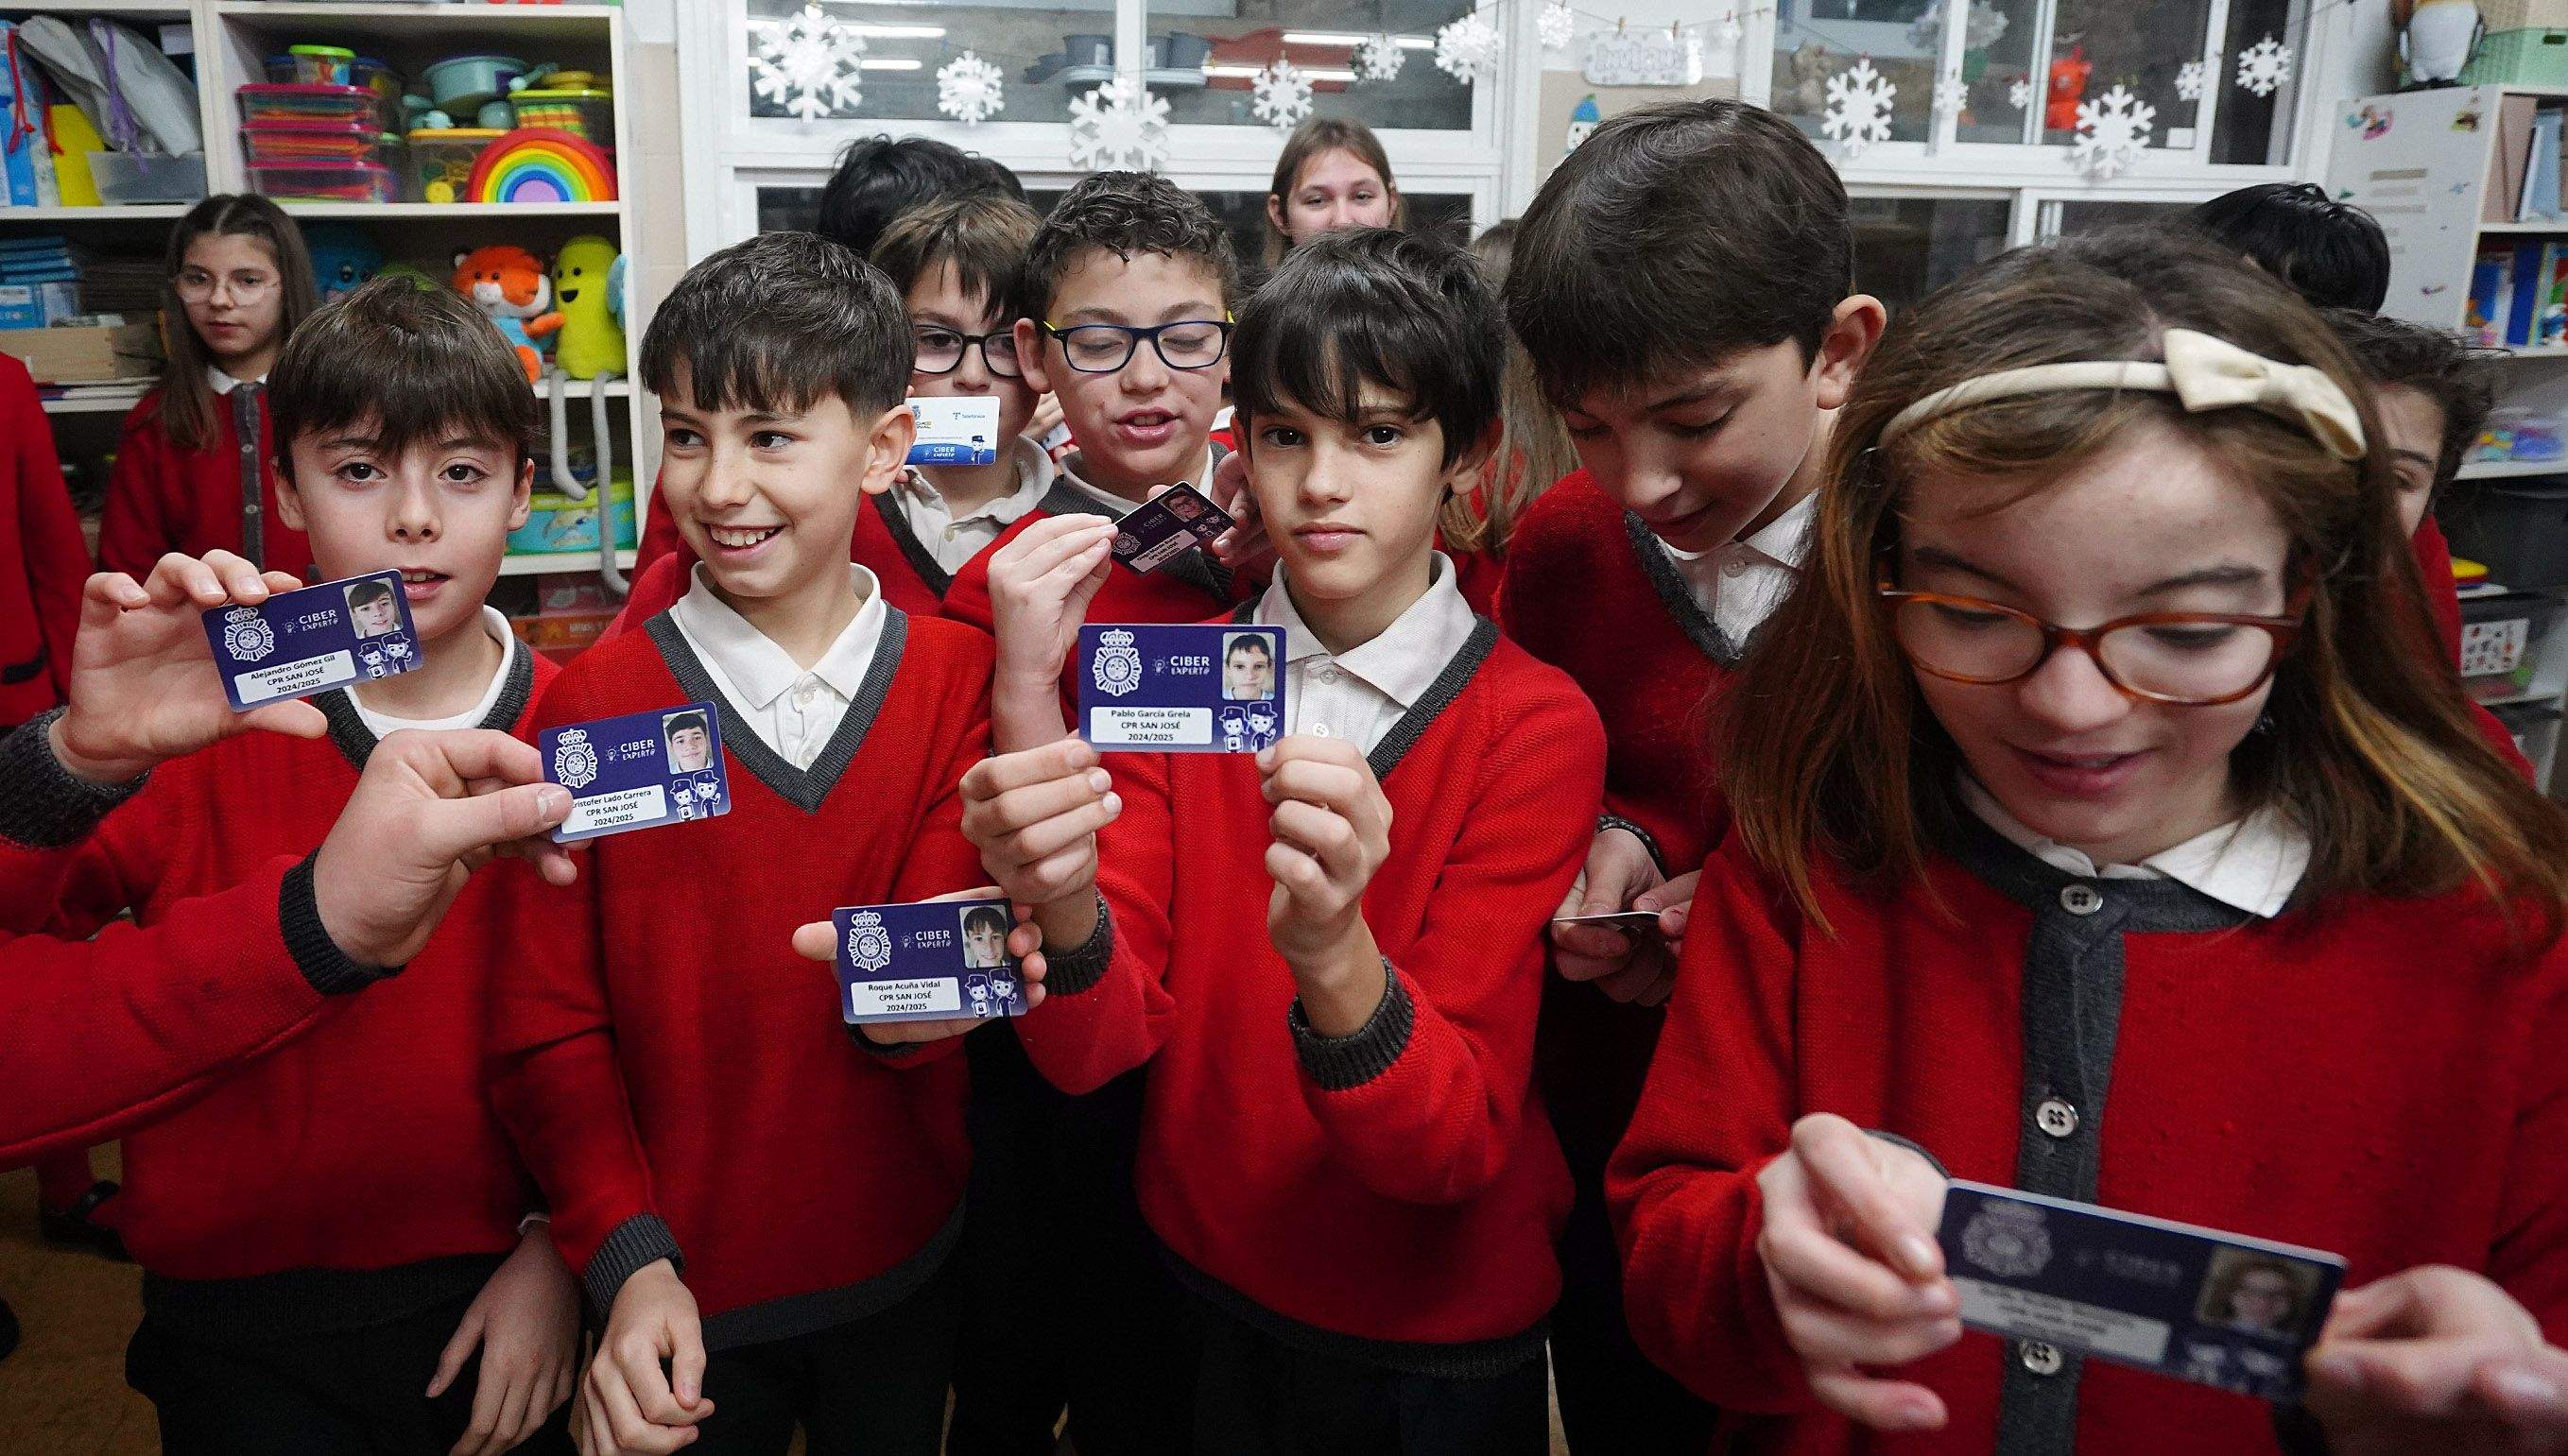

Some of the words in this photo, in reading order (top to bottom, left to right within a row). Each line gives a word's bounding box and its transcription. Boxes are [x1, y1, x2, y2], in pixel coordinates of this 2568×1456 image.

[299, 609, 336, 625] CIBER
[1170, 655, 1211, 667] CIBER
[250, 666, 292, 679] Alejandro
[293, 659, 323, 669] Gómez
[267, 677, 284, 686] CPR
[284, 673, 303, 681] SAN
[304, 666, 324, 677] JOSÉ
[276, 677, 321, 694] 2024/2025
[1111, 709, 1136, 717] Pablo
[1137, 710, 1165, 718] García
[1167, 710, 1191, 718] Grela
[1160, 721, 1181, 729] JOSÉ
[1128, 733, 1174, 742] 2024/2025
[620, 739, 655, 753] CIBER
[573, 798, 602, 809] ristofer
[603, 794, 622, 803] Lado
[623, 790, 652, 799] Carrera
[586, 807, 601, 816] CPR
[603, 805, 619, 814] SAN
[620, 800, 639, 811] JOSÉ
[594, 814, 634, 827] 2024/2025
[915, 930, 951, 941] CIBER
[868, 984, 893, 992] Roque
[914, 990, 932, 1000] JOSÉ
[887, 1003, 927, 1012] 2024/2025
